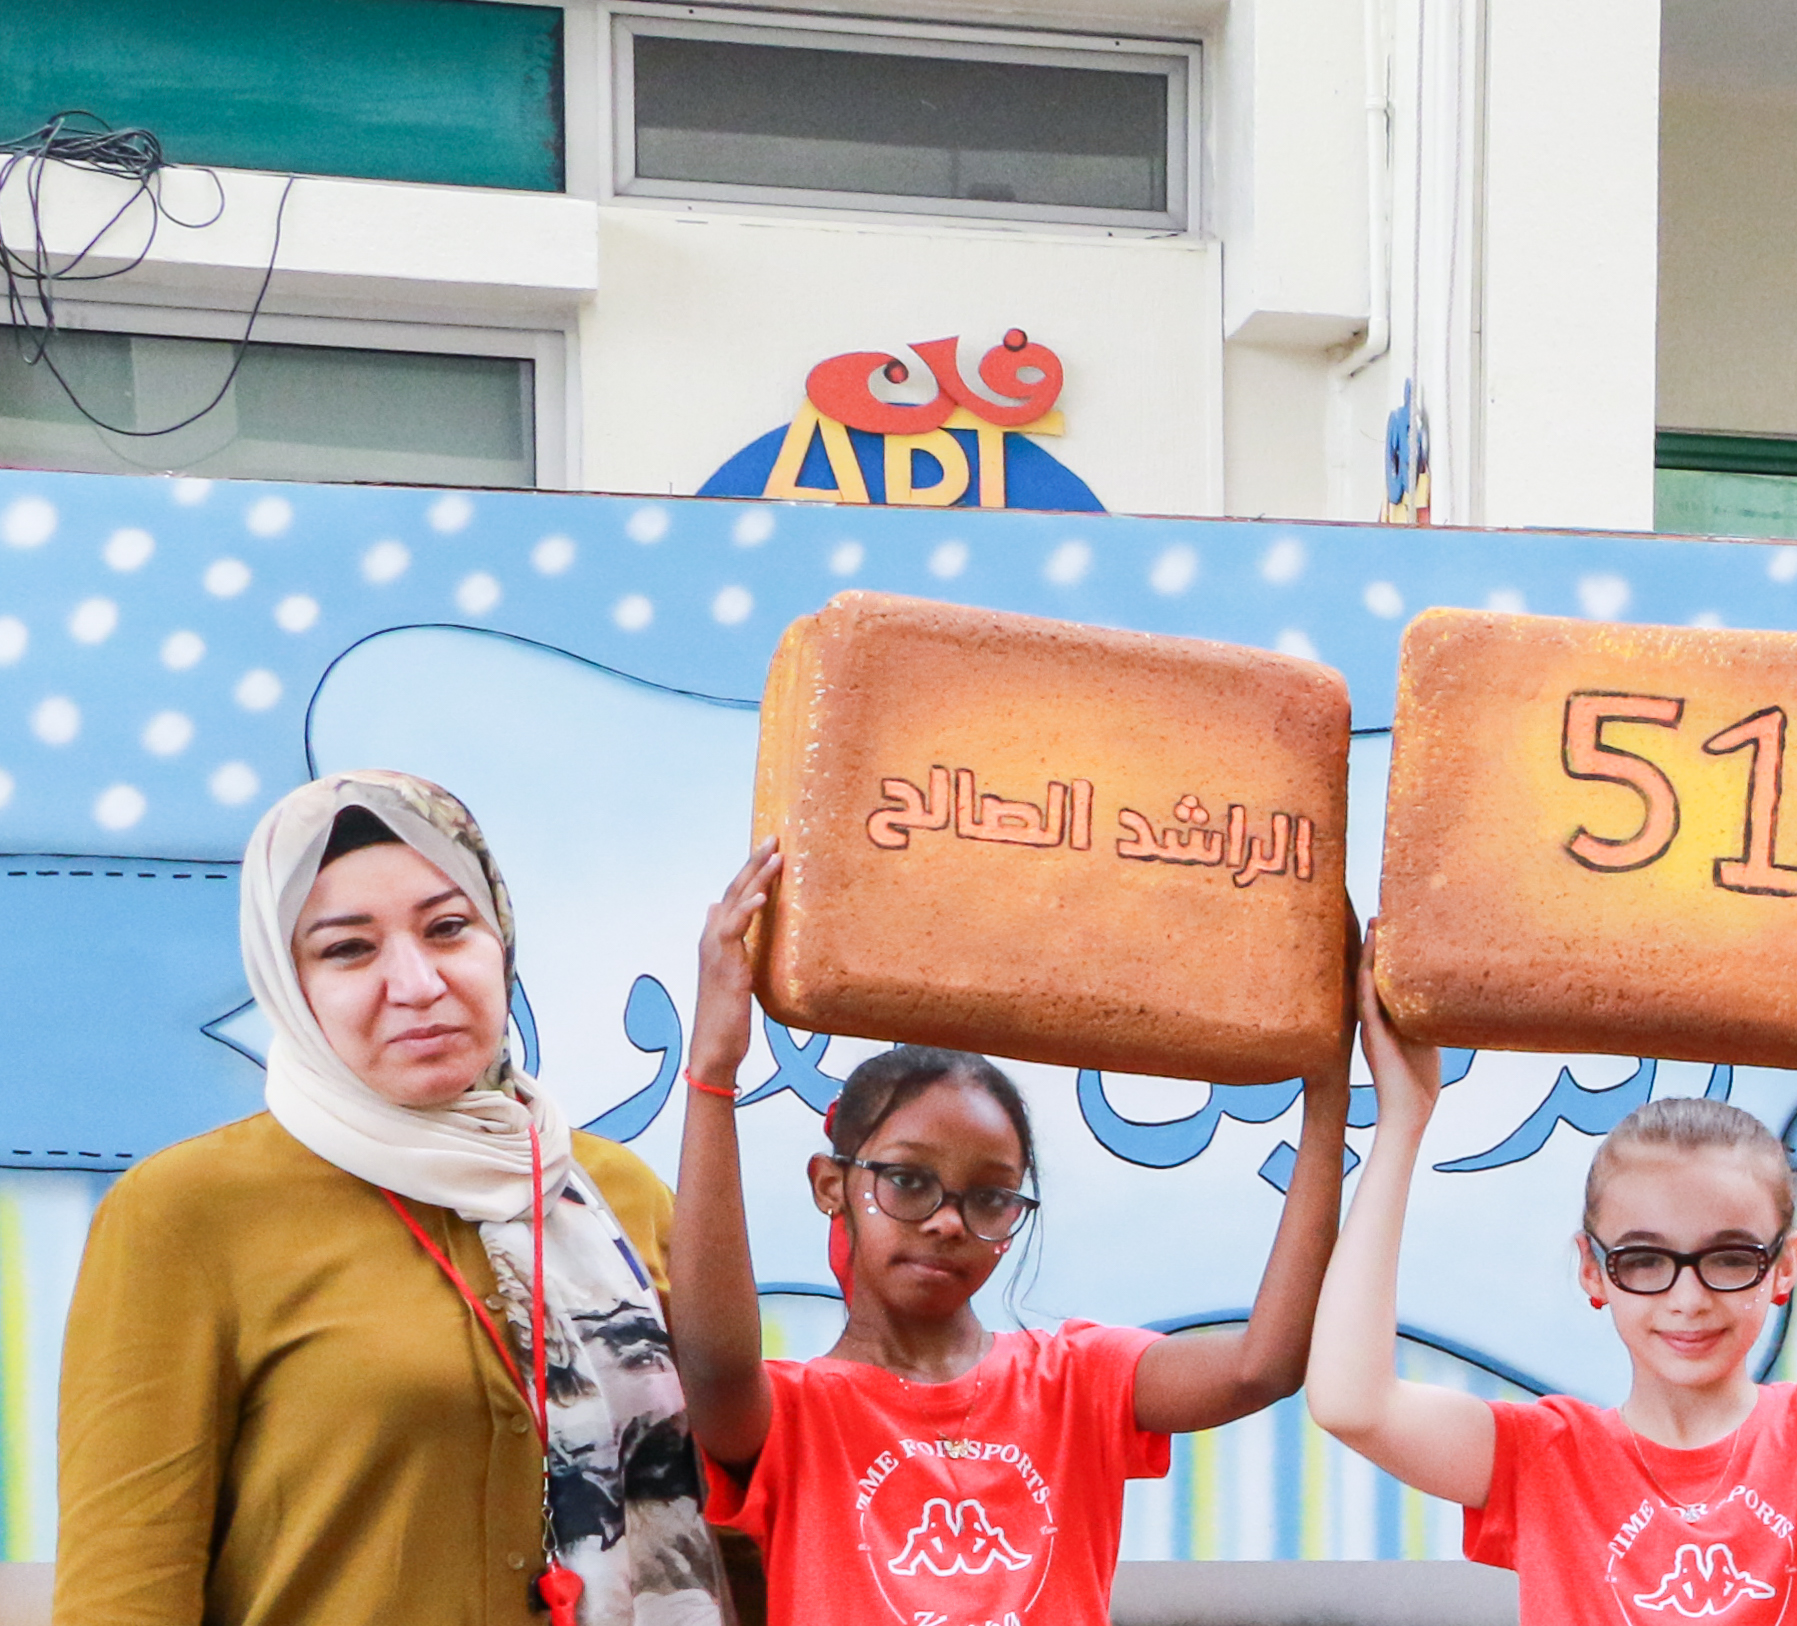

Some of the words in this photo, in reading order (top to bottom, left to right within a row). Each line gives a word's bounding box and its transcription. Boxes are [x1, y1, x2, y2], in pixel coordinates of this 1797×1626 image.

[866, 765, 1094, 852] الصالح
[1116, 794, 1316, 888] الراشد
[965, 1440, 1051, 1504] SPORTS
[1607, 1499, 1655, 1559] TIME
[1715, 1484, 1795, 1539] PORTS
